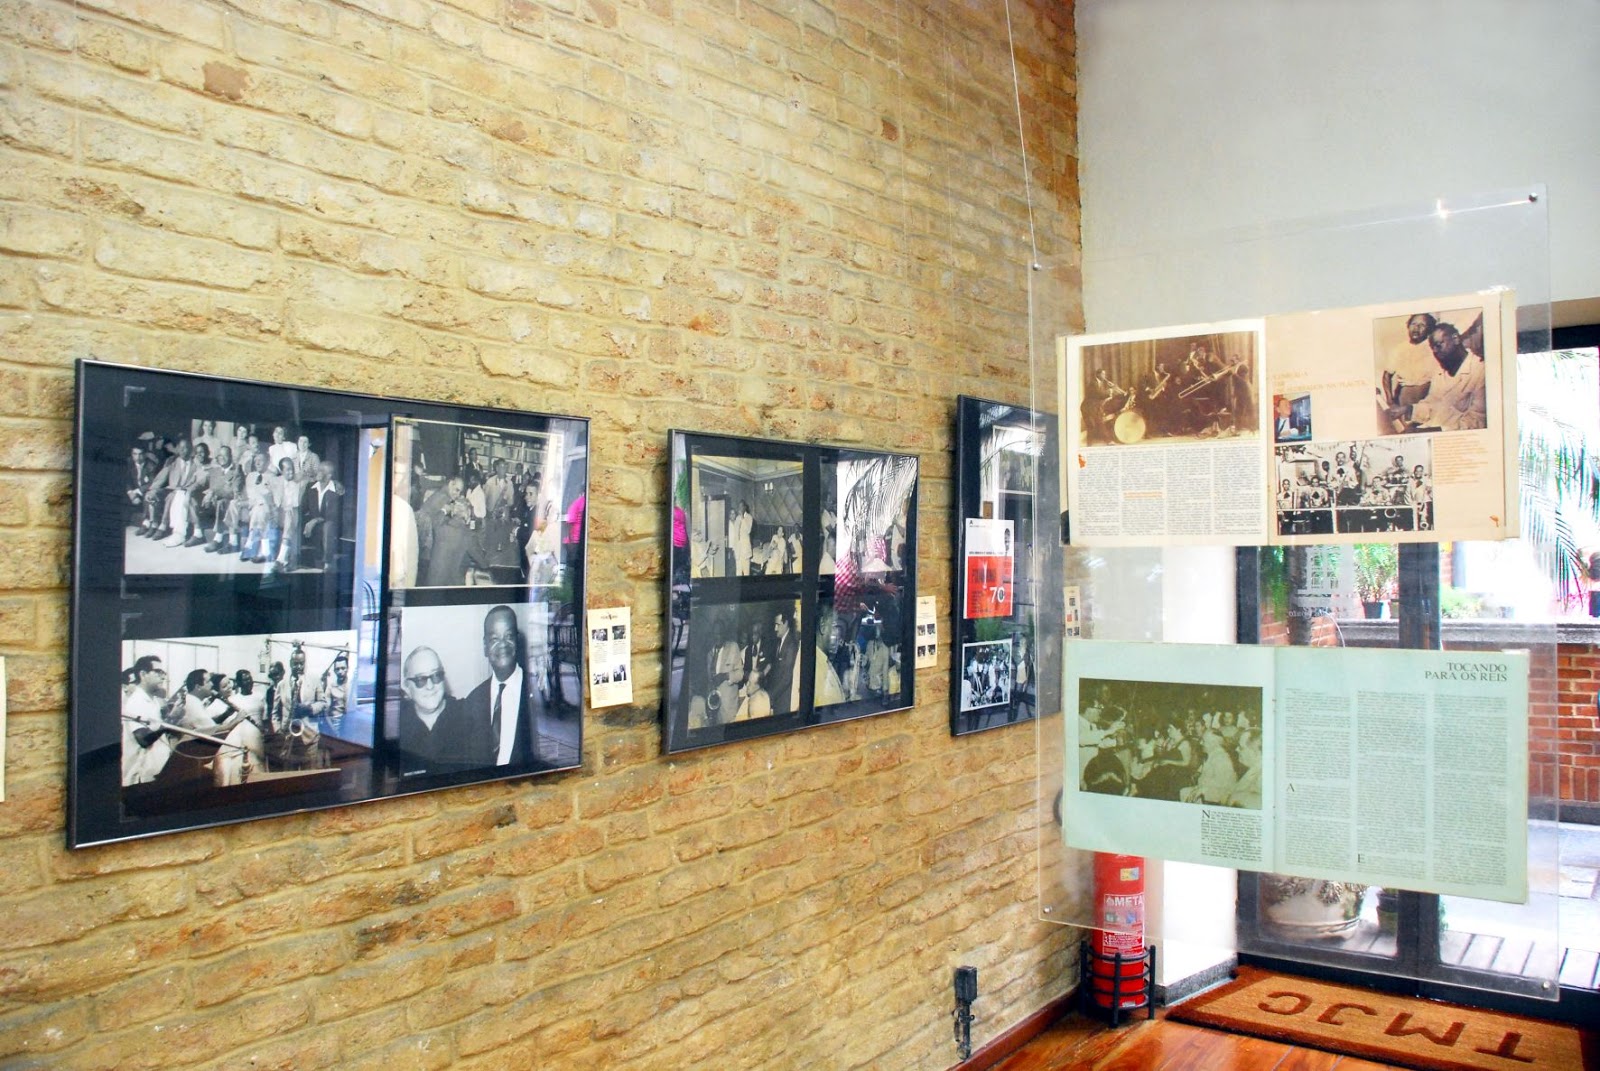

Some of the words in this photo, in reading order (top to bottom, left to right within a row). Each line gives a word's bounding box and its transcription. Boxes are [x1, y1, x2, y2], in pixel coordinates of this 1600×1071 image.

[989, 586, 1005, 603] 70
[1446, 662, 1507, 673] TOCANDO
[1424, 670, 1458, 680] PARA
[1460, 671, 1477, 681] OS
[1480, 672, 1508, 682] REIS
